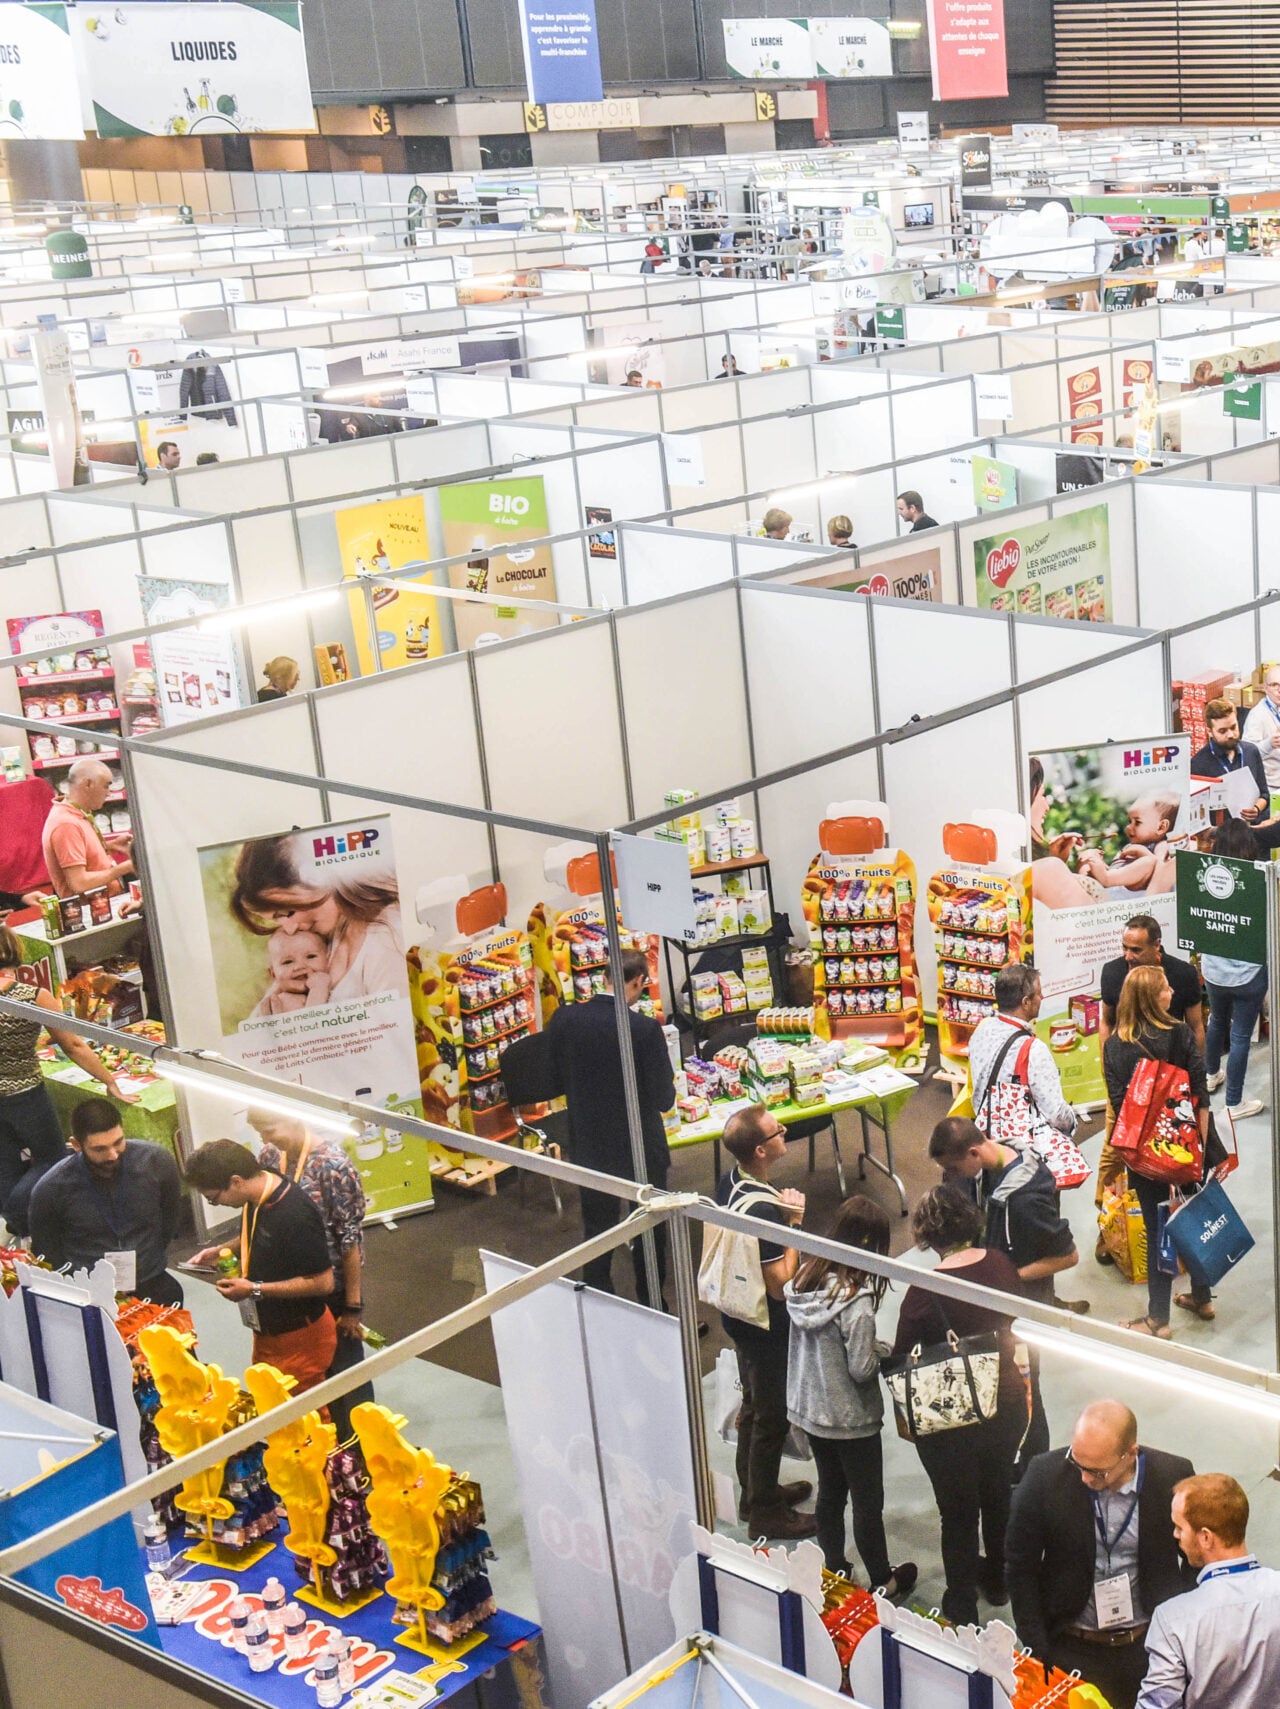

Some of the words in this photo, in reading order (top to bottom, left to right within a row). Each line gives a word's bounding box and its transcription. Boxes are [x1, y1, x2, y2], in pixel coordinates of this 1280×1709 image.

[751, 38, 758, 46] LE
[839, 36, 846, 45] LE
[171, 41, 237, 62] LIQUIDES
[553, 103, 632, 119] COMPTOIR
[489, 494, 529, 515] BIO
[389, 523, 419, 532] NOUVEAU
[991, 548, 1018, 580] Liebig
[1027, 559, 1039, 569] LES
[1040, 541, 1096, 566] INCONTOURNABLES
[505, 568, 547, 582] CHOCOLAT
[1028, 570, 1036, 579] DE
[1038, 564, 1057, 576] VOTRE
[1060, 557, 1077, 569] RAYON
[896, 572, 928, 598] 100%
[1124, 746, 1180, 768] HiPP
[1124, 764, 1180, 776] BIOLOGIQUE
[313, 828, 379, 858] HiPP
[315, 849, 381, 867] BIOLOGIQUE
[818, 869, 850, 880] 100%
[855, 867, 891, 878] Fruits
[940, 872, 968, 886] 100%
[971, 879, 1003, 891] Fruits
[647, 882, 661, 892] HIPP
[1050, 908, 1095, 920] Apprendre
[1096, 907, 1104, 915] le
[1106, 903, 1125, 914] goût
[1150, 895, 1177, 906] enfant
[1190, 906, 1238, 923] NUTRITION
[1240, 915, 1251, 926] ET
[568, 909, 599, 926] 100%
[1074, 920, 1094, 928] c'est
[1096, 916, 1112, 925] tout
[684, 929, 696, 940] E30
[1206, 921, 1235, 934] SANTE
[456, 947, 483, 965] 100%
[485, 935, 516, 954] Fruits
[1179, 938, 1195, 949] E32
[243, 1018, 279, 1032] Donner
[282, 1016, 292, 1025] le
[293, 1008, 330, 1022] meilleur
[344, 1003, 361, 1013] son
[363, 994, 395, 1010] enfant
[274, 1027, 297, 1038] c'est
[300, 1022, 319, 1033] tout
[321, 1010, 370, 1028] naturel.
[242, 1051, 260, 1059] Pour
[261, 1048, 276, 1057] que
[277, 1043, 297, 1053] Bébé
[299, 1035, 340, 1048] commence
[341, 1031, 358, 1042] avec
[359, 1028, 367, 1037] le
[260, 1052, 300, 1065] découvrez
[301, 1048, 308, 1057] la
[310, 1042, 342, 1054] dernière
[343, 1034, 384, 1049] génération
[275, 1063, 285, 1071] de
[286, 1059, 304, 1069] Laits
[1200, 1214, 1229, 1243] SOLINEST
